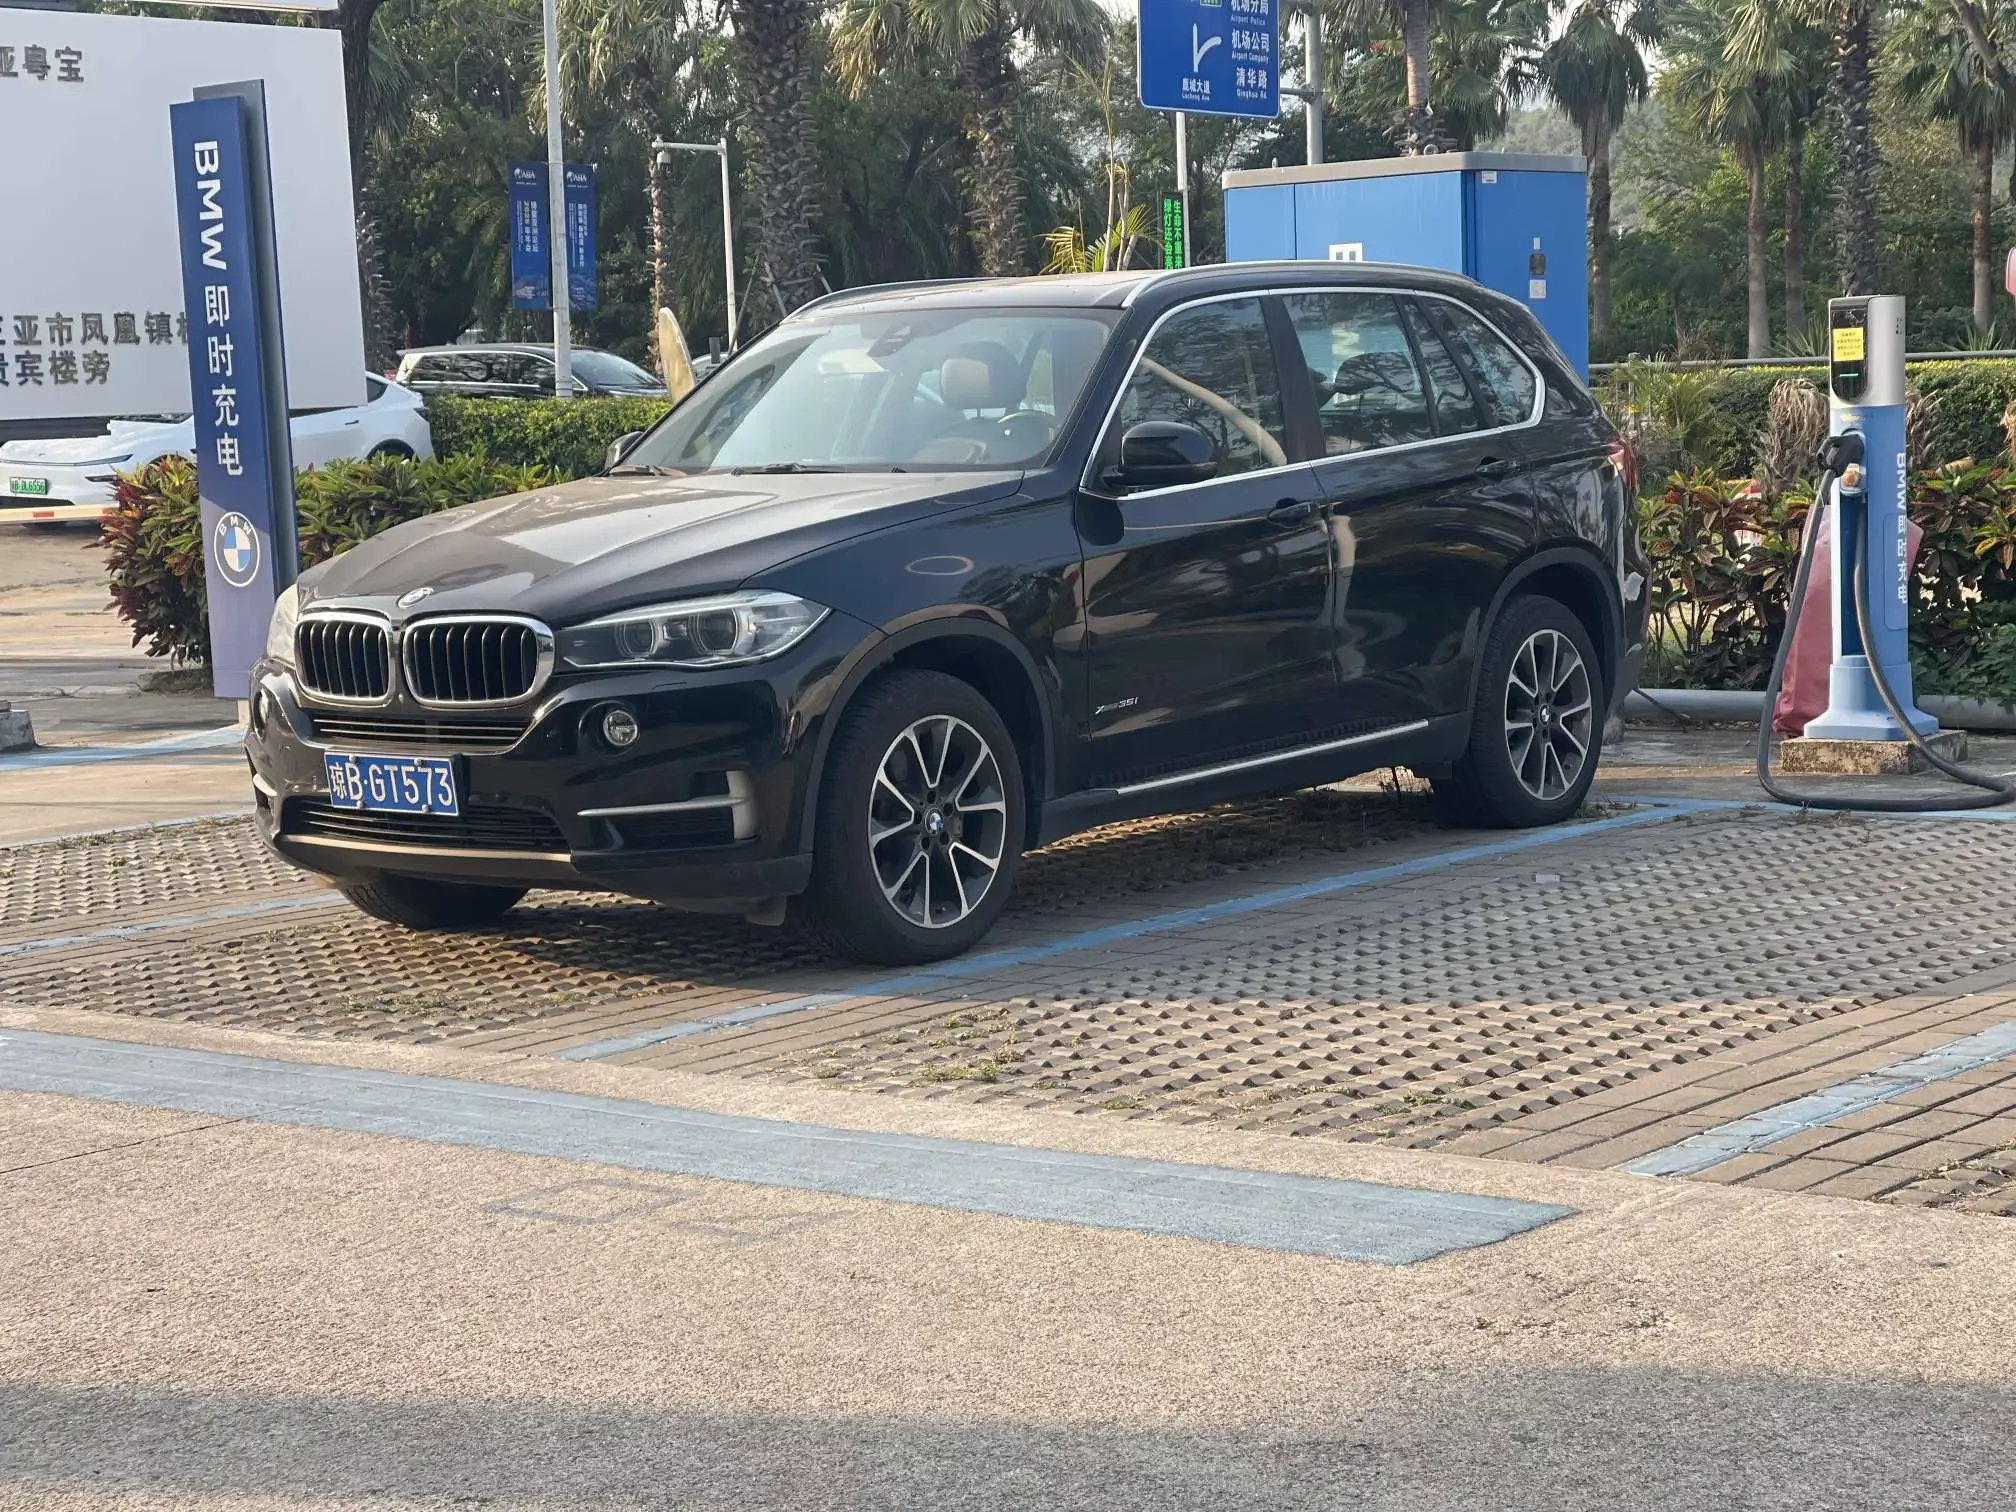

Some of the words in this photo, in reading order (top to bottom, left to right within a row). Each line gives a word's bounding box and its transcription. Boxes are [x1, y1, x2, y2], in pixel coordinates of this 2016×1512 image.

[1232, 28, 1269, 52] 机场公司
[1232, 50, 1247, 60] Airport
[0, 44, 84, 82] 亚粤宝
[1237, 67, 1267, 89] 清华路
[194, 140, 227, 270] BMW
[0, 310, 188, 347] 亚市凤凰镇
[205, 285, 243, 476] 即时充电
[1896, 452, 1907, 510] BMW
[218, 515, 252, 537] BMW
